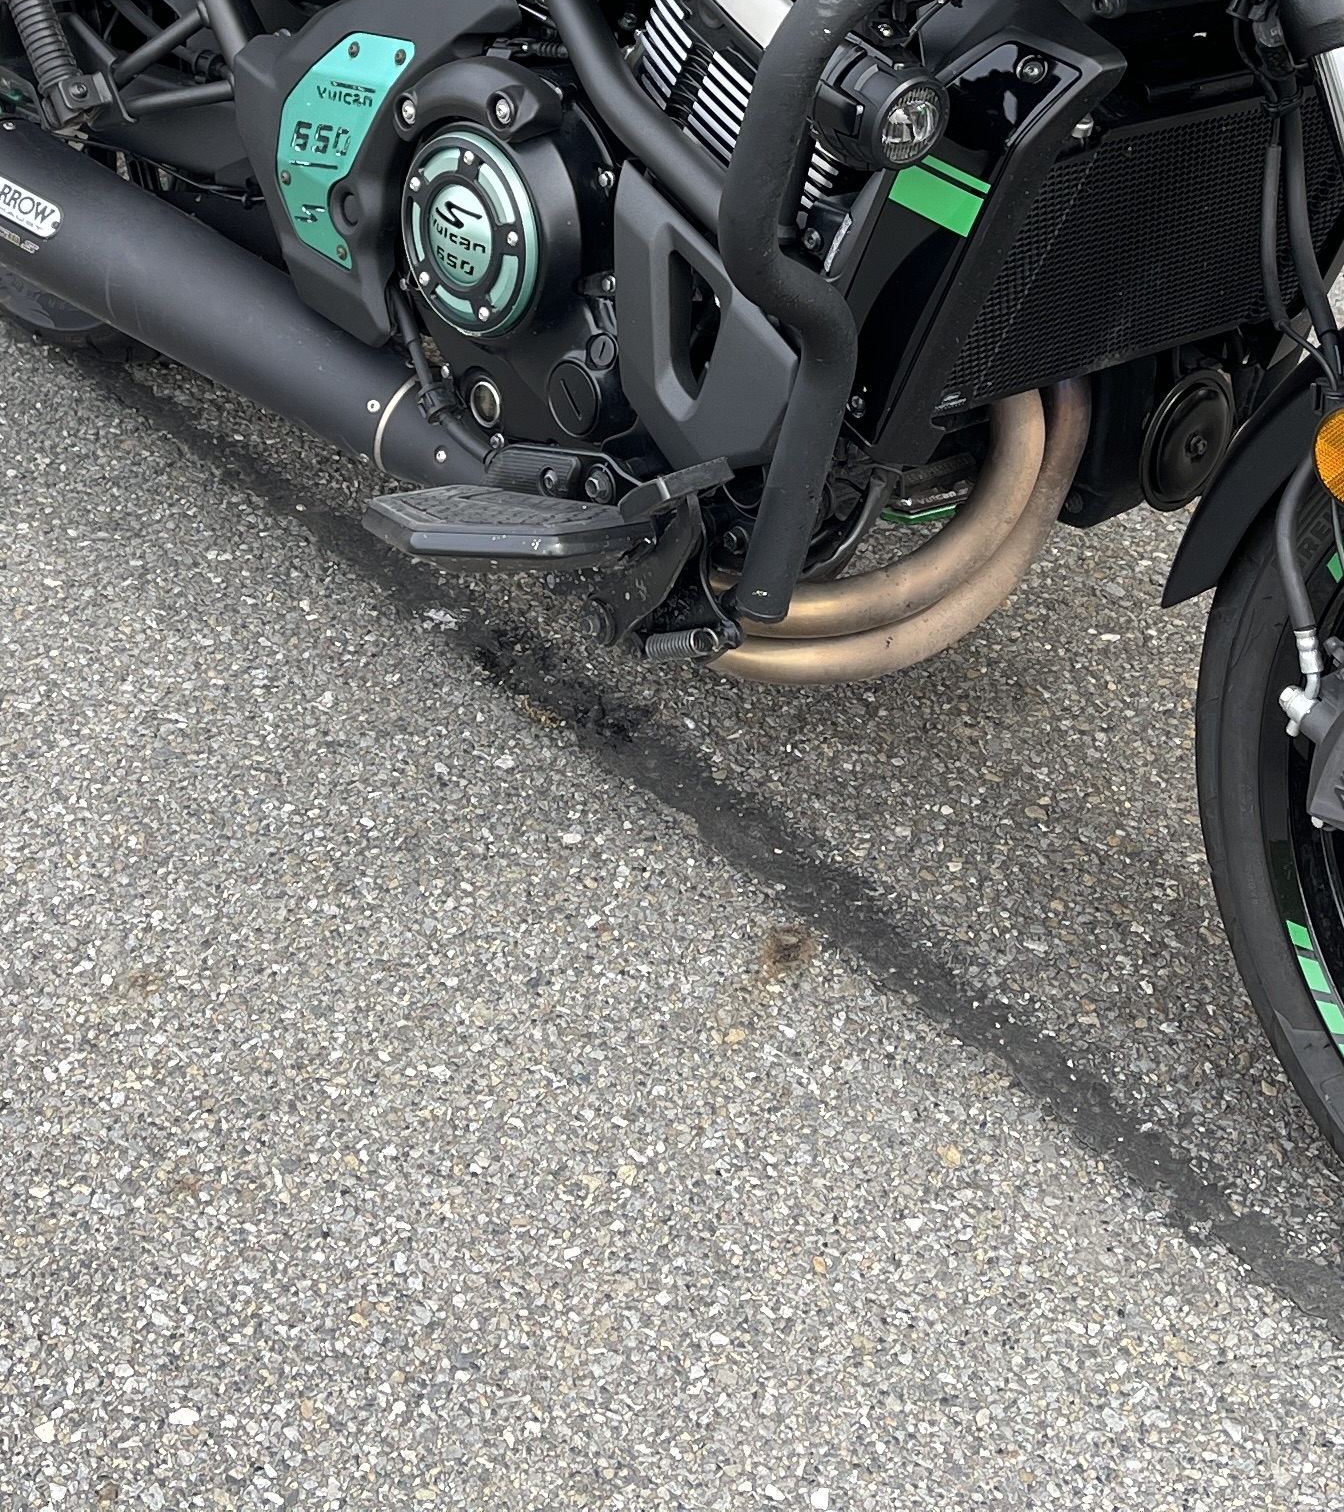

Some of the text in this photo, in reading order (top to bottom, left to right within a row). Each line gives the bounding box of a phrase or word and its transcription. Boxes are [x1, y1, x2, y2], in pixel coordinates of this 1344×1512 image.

[316, 85, 374, 107] Vulcan
[290, 120, 352, 157] 650
[436, 245, 475, 277] 650
